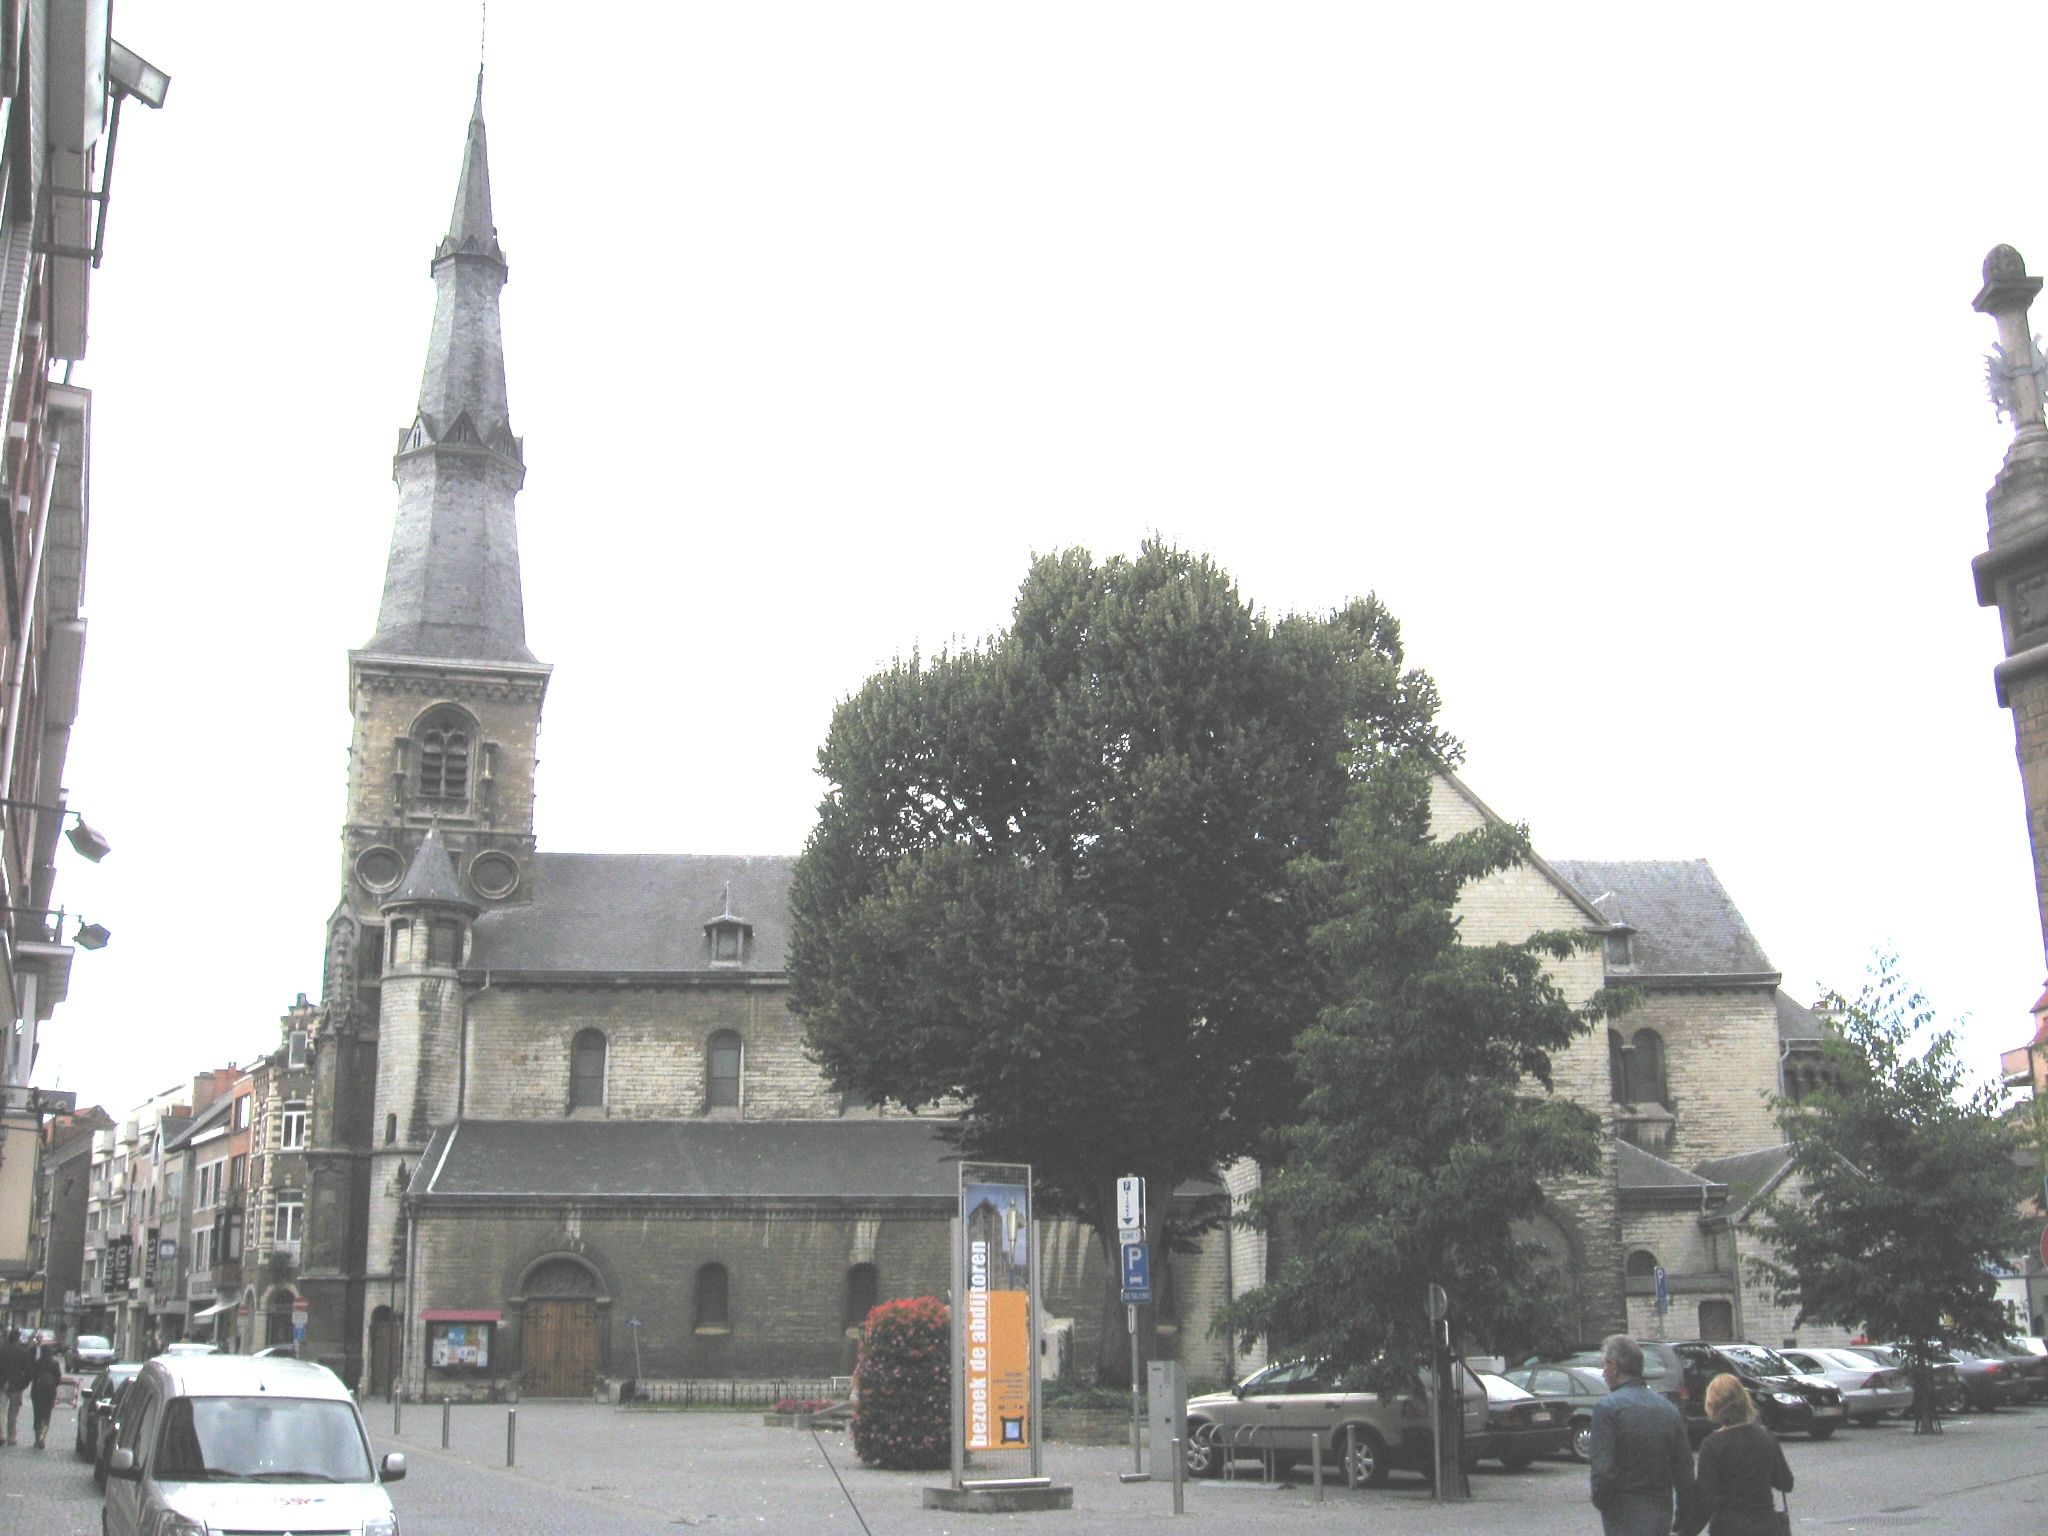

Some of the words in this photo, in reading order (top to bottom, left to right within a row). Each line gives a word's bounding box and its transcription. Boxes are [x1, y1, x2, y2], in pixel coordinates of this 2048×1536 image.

[1128, 1247, 1142, 1270] P
[1657, 1268, 1664, 1285] P
[969, 1241, 987, 1343] abdijtoren
[970, 1346, 987, 1371] de
[970, 1377, 987, 1446] bezoek
